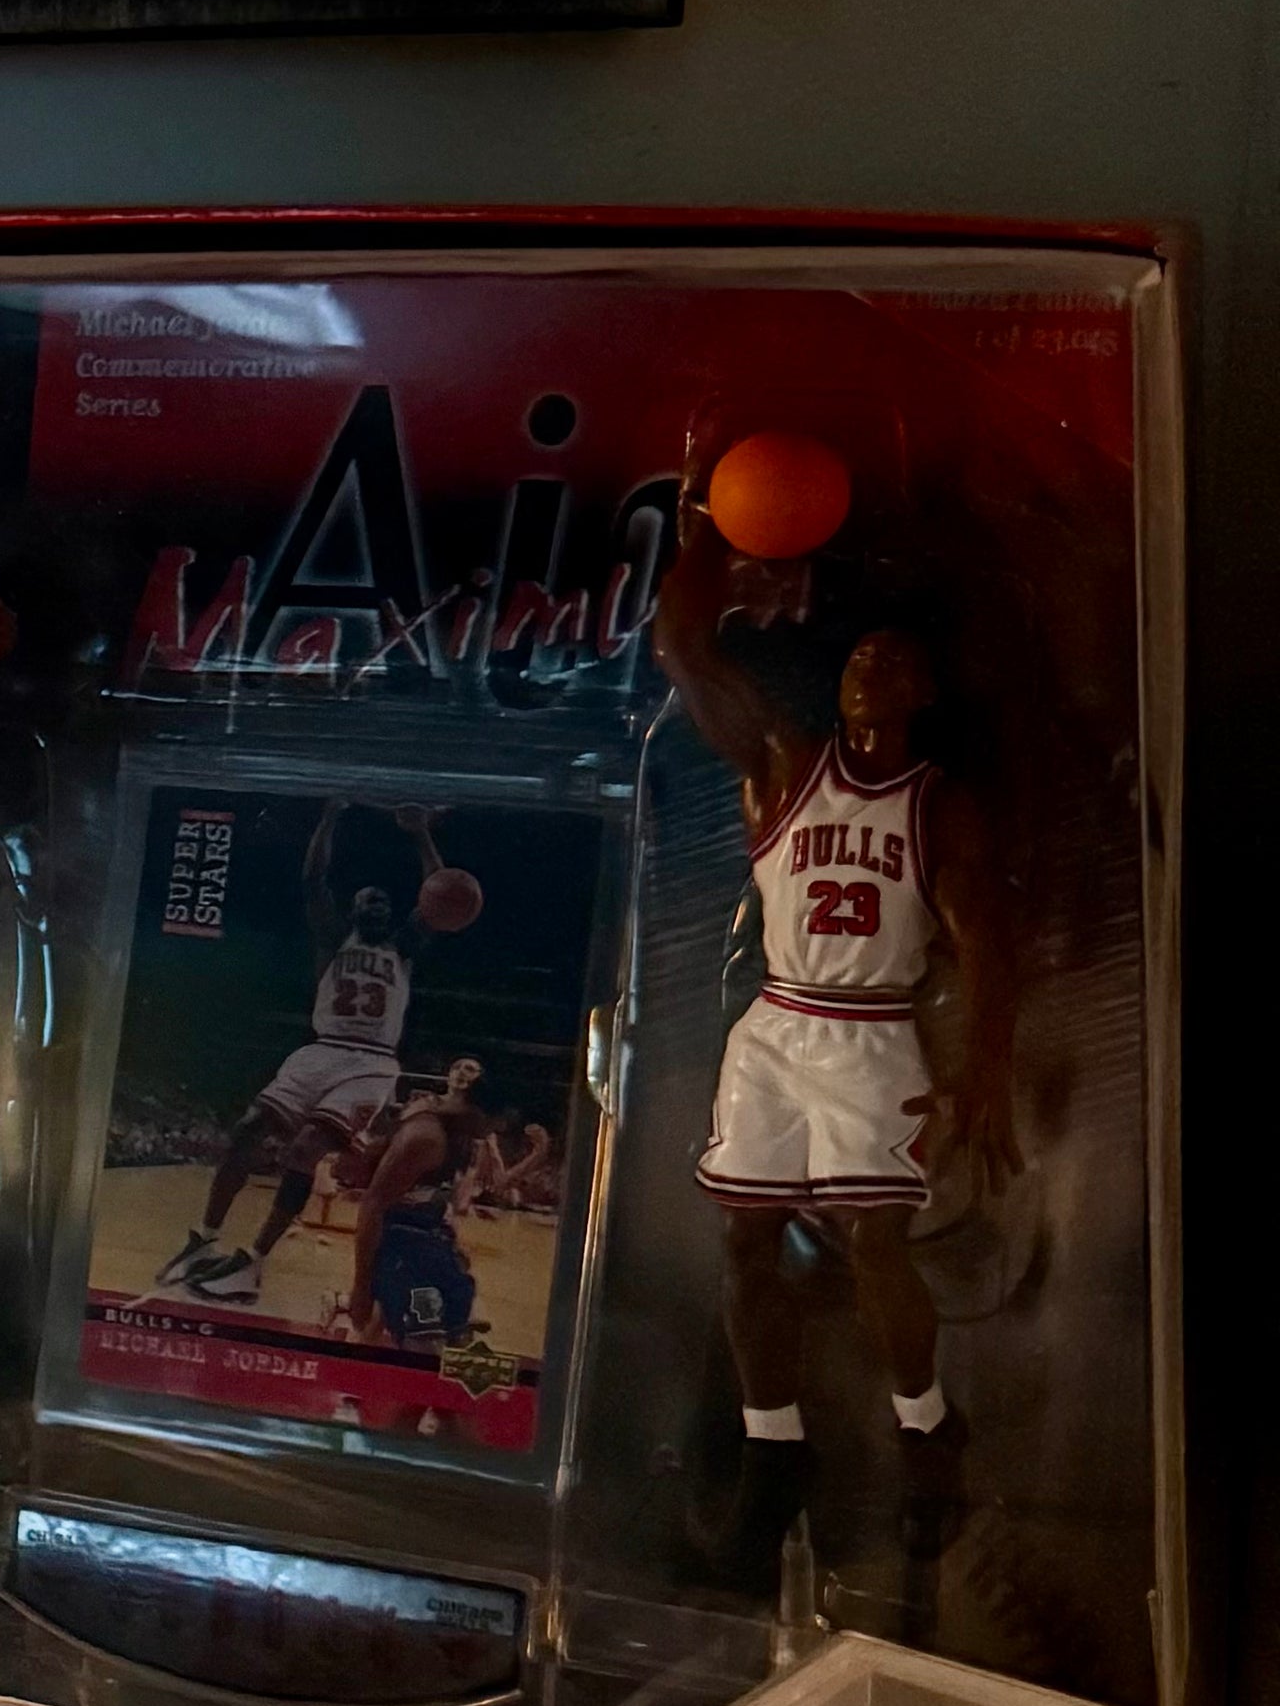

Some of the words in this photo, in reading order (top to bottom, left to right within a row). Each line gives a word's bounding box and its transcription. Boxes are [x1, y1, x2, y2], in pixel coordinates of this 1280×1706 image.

[74, 389, 163, 418] Series
[165, 821, 202, 923] SUPER
[193, 821, 233, 925] STARS
[791, 824, 904, 882] BULLS
[807, 880, 881, 937] 23
[335, 979, 386, 1018] 23
[104, 1307, 173, 1331] BULLS
